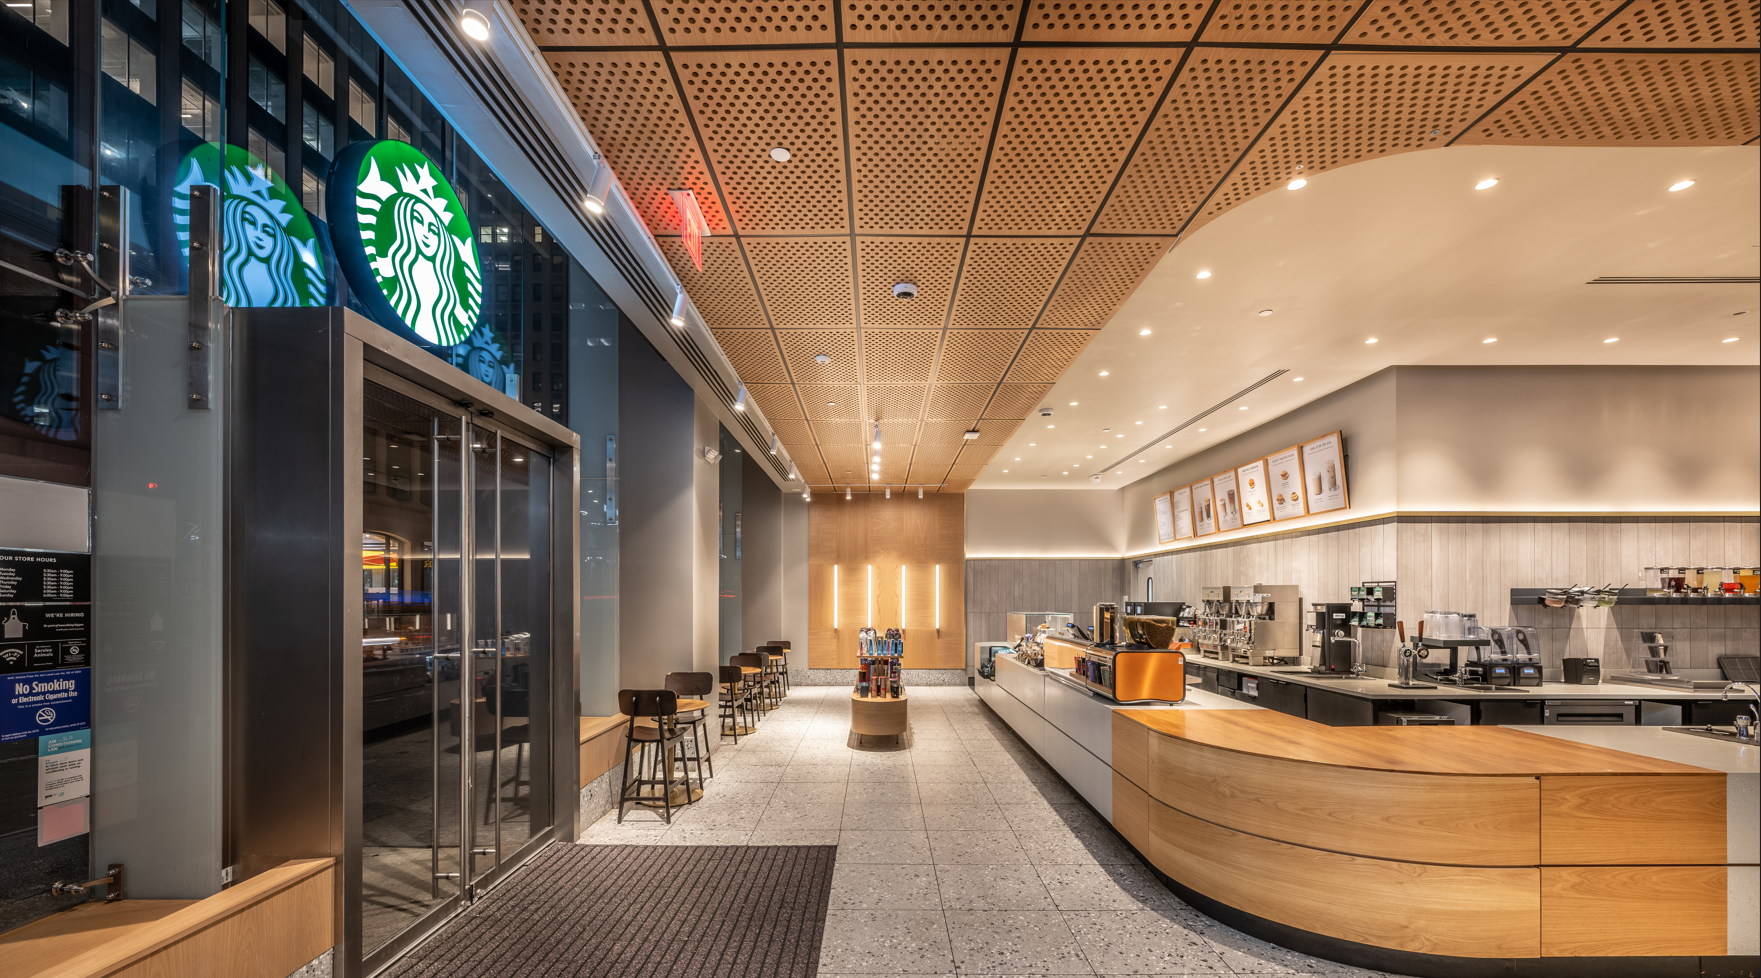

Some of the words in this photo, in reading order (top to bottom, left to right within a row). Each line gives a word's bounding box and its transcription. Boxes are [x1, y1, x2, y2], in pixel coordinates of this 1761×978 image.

[15, 683, 29, 695] No
[32, 679, 75, 693] Smoking
[19, 694, 44, 703] Electronic
[45, 692, 68, 700] Cigarette
[48, 739, 82, 748] CONDITIONING
